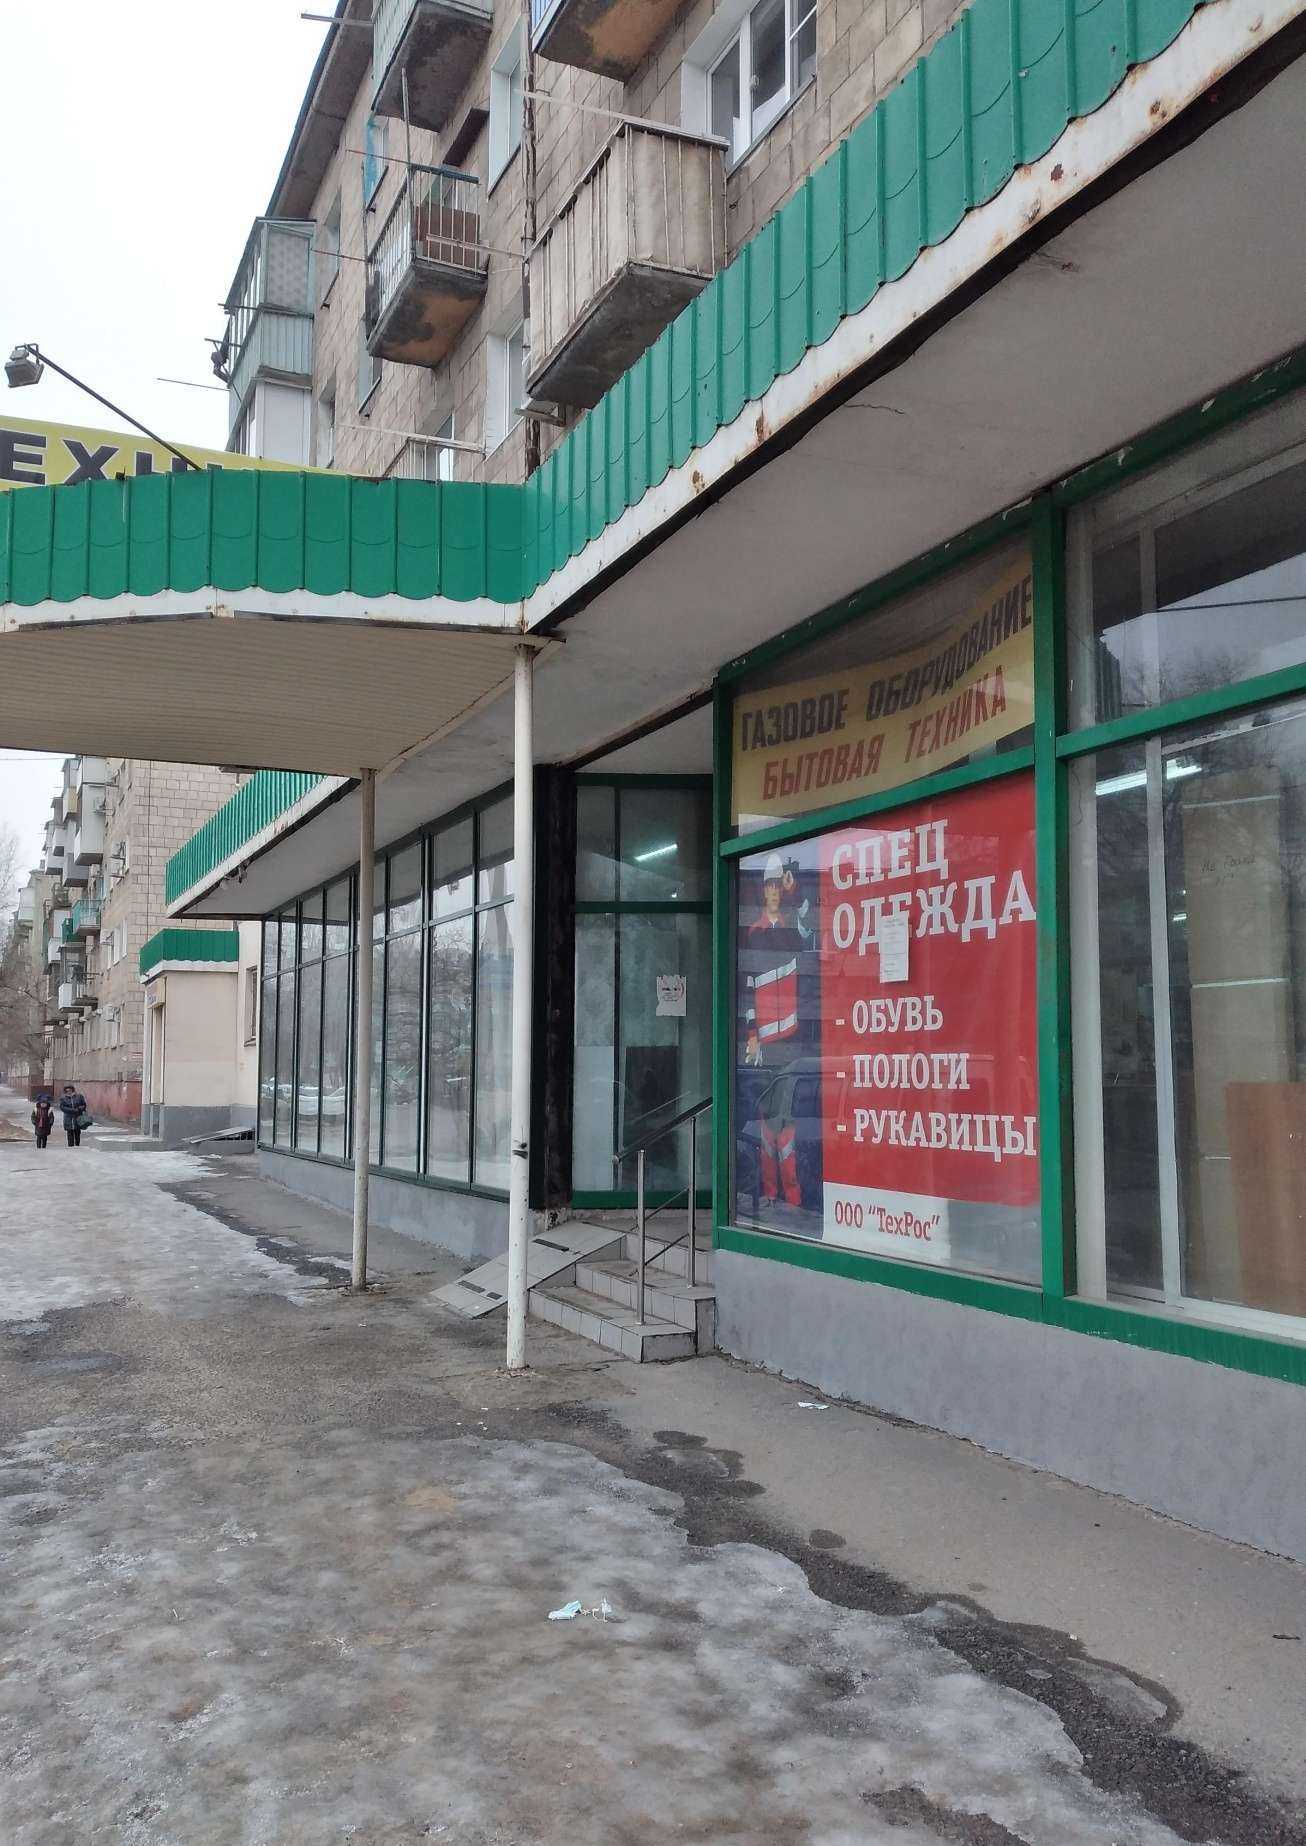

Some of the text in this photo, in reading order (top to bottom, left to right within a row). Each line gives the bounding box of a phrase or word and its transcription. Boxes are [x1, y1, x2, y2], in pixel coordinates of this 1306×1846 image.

[741, 573, 1032, 751] ГАЗОВОЕ ОБОРУДОВАНИЕ
[762, 665, 1007, 800] БЫТОВАЯ ТЕХНИКА
[832, 819, 948, 890] СПЕЦ
[834, 1200, 863, 1228] ООО
